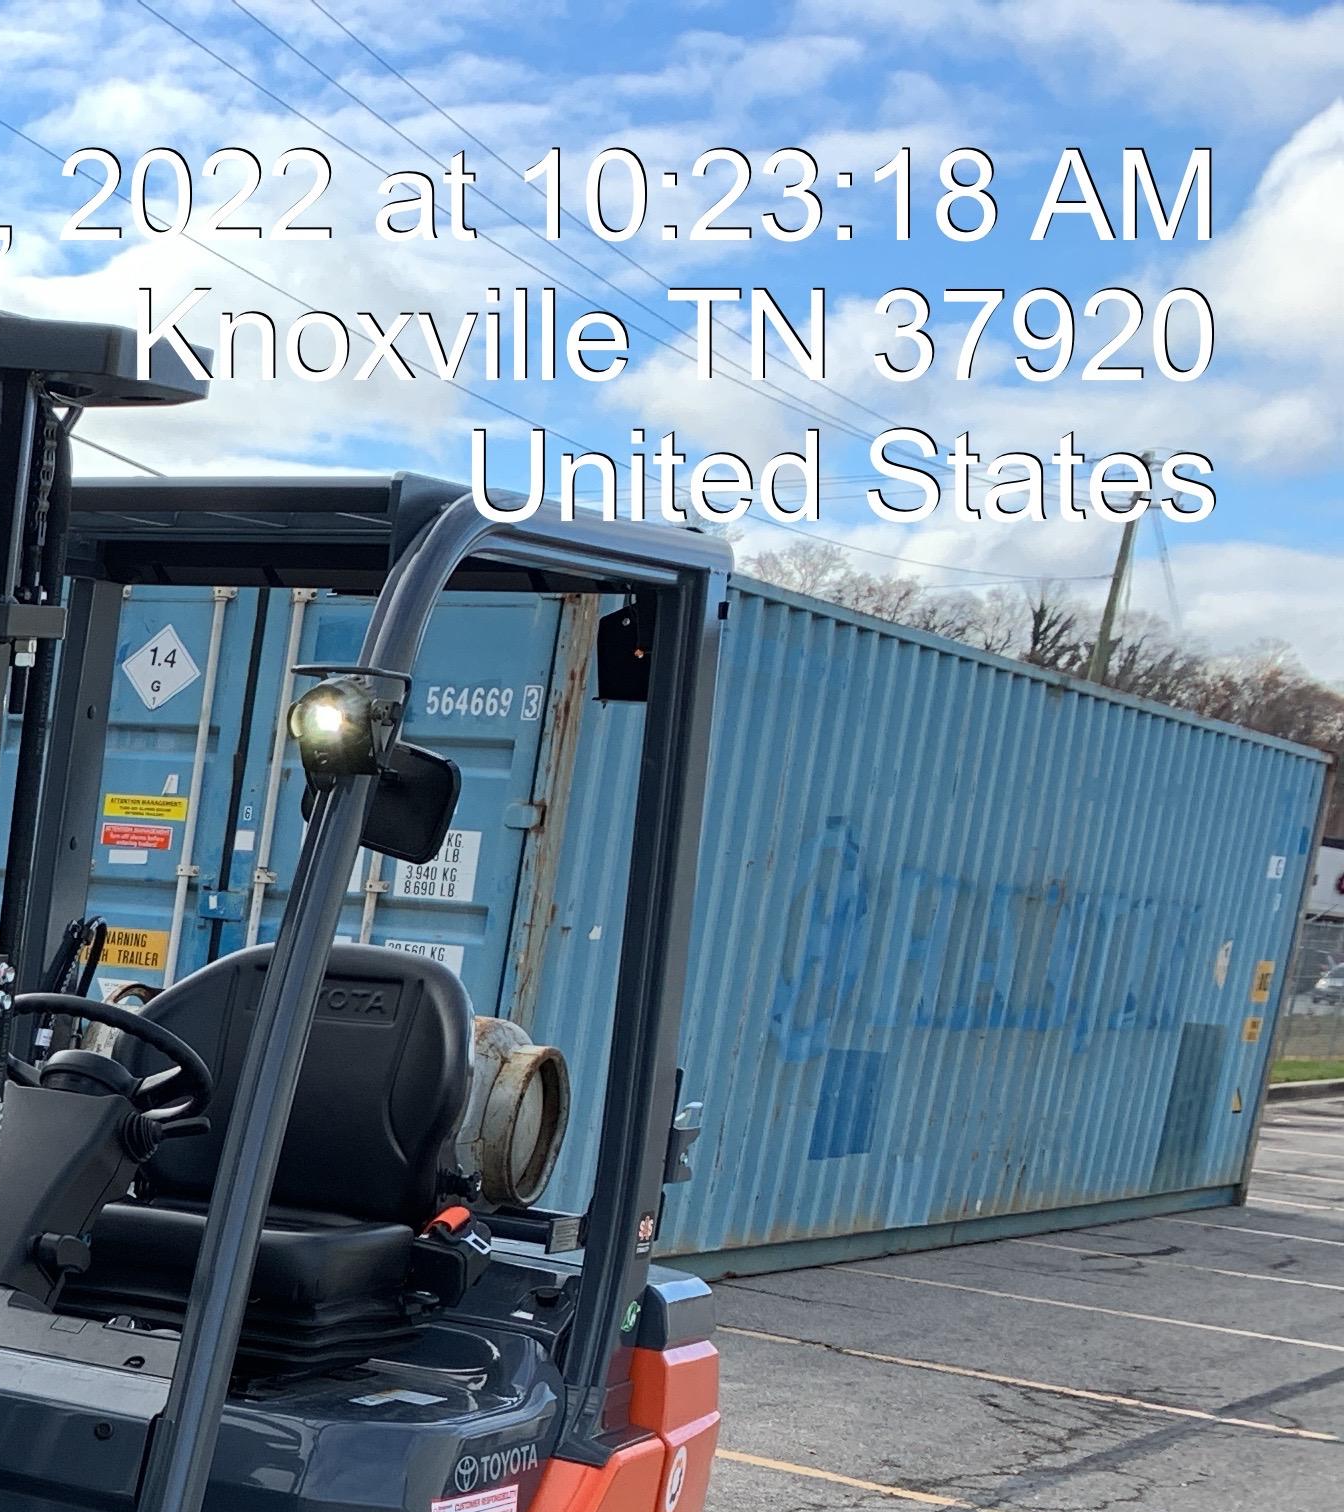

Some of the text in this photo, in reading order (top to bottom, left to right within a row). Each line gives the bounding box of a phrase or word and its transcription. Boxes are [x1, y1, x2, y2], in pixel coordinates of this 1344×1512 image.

[149, 646, 178, 668] 1.4
[150, 680, 162, 692] G
[425, 686, 540, 718] 564669 3
[117, 949, 159, 966] TRAILER
[480, 1443, 538, 1482] TOYOTA
